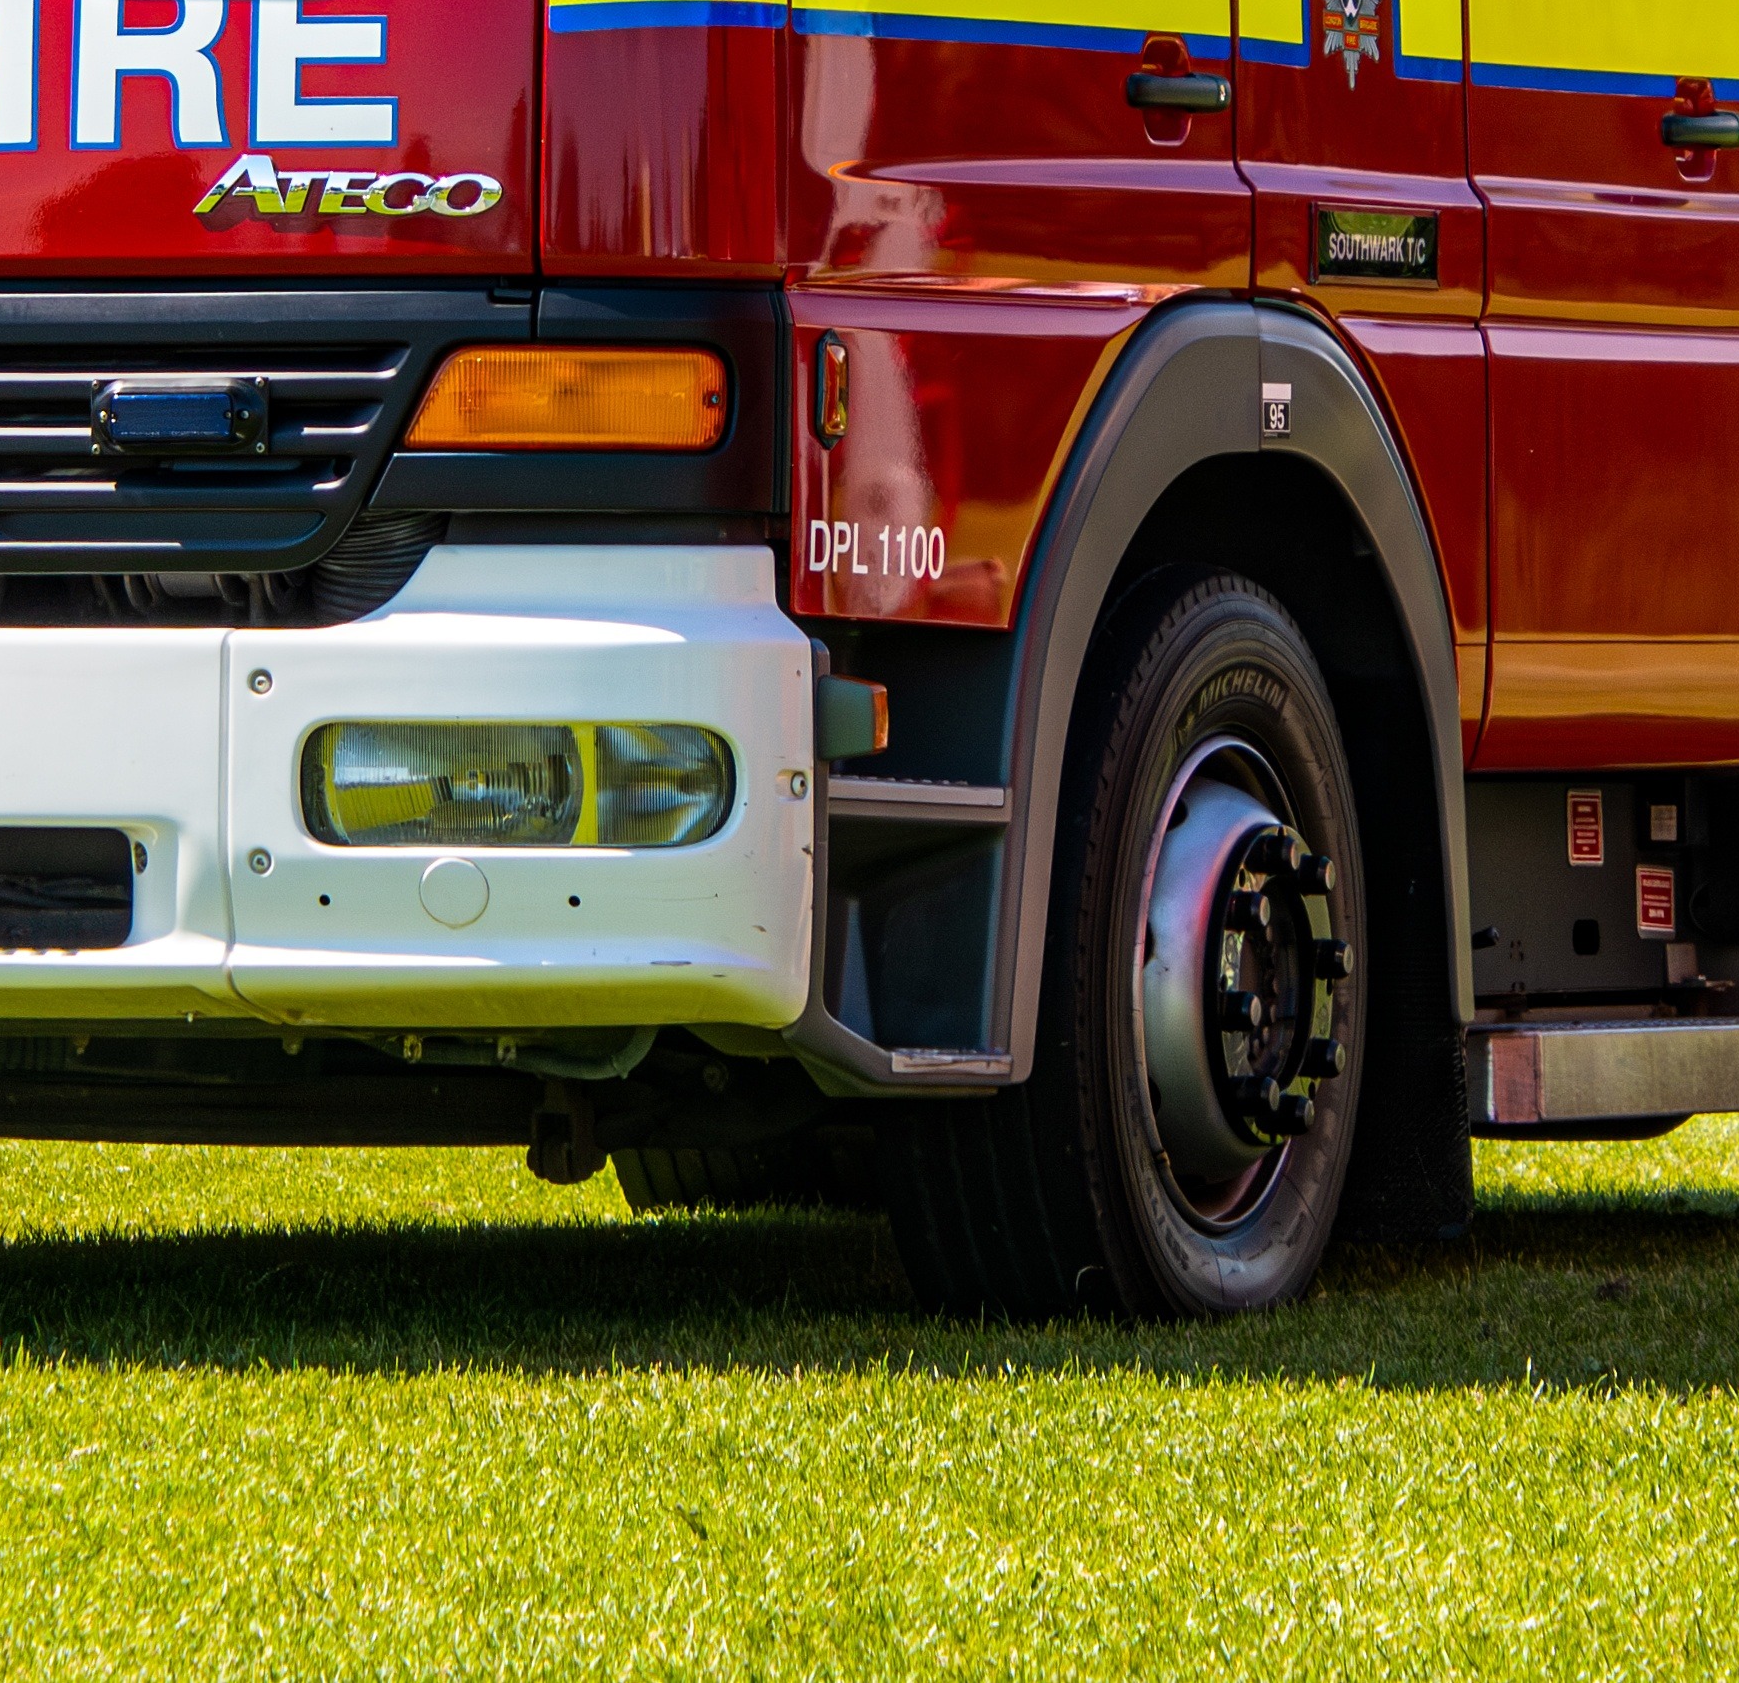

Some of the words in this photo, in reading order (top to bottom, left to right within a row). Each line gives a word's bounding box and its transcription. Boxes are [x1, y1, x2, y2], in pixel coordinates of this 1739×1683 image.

[1329, 233, 1405, 263] SOUTHWARK
[1269, 403, 1285, 429] 95
[809, 520, 868, 574] DPL
[879, 525, 945, 580] 1100
[1198, 668, 1286, 711] MICHELIN
